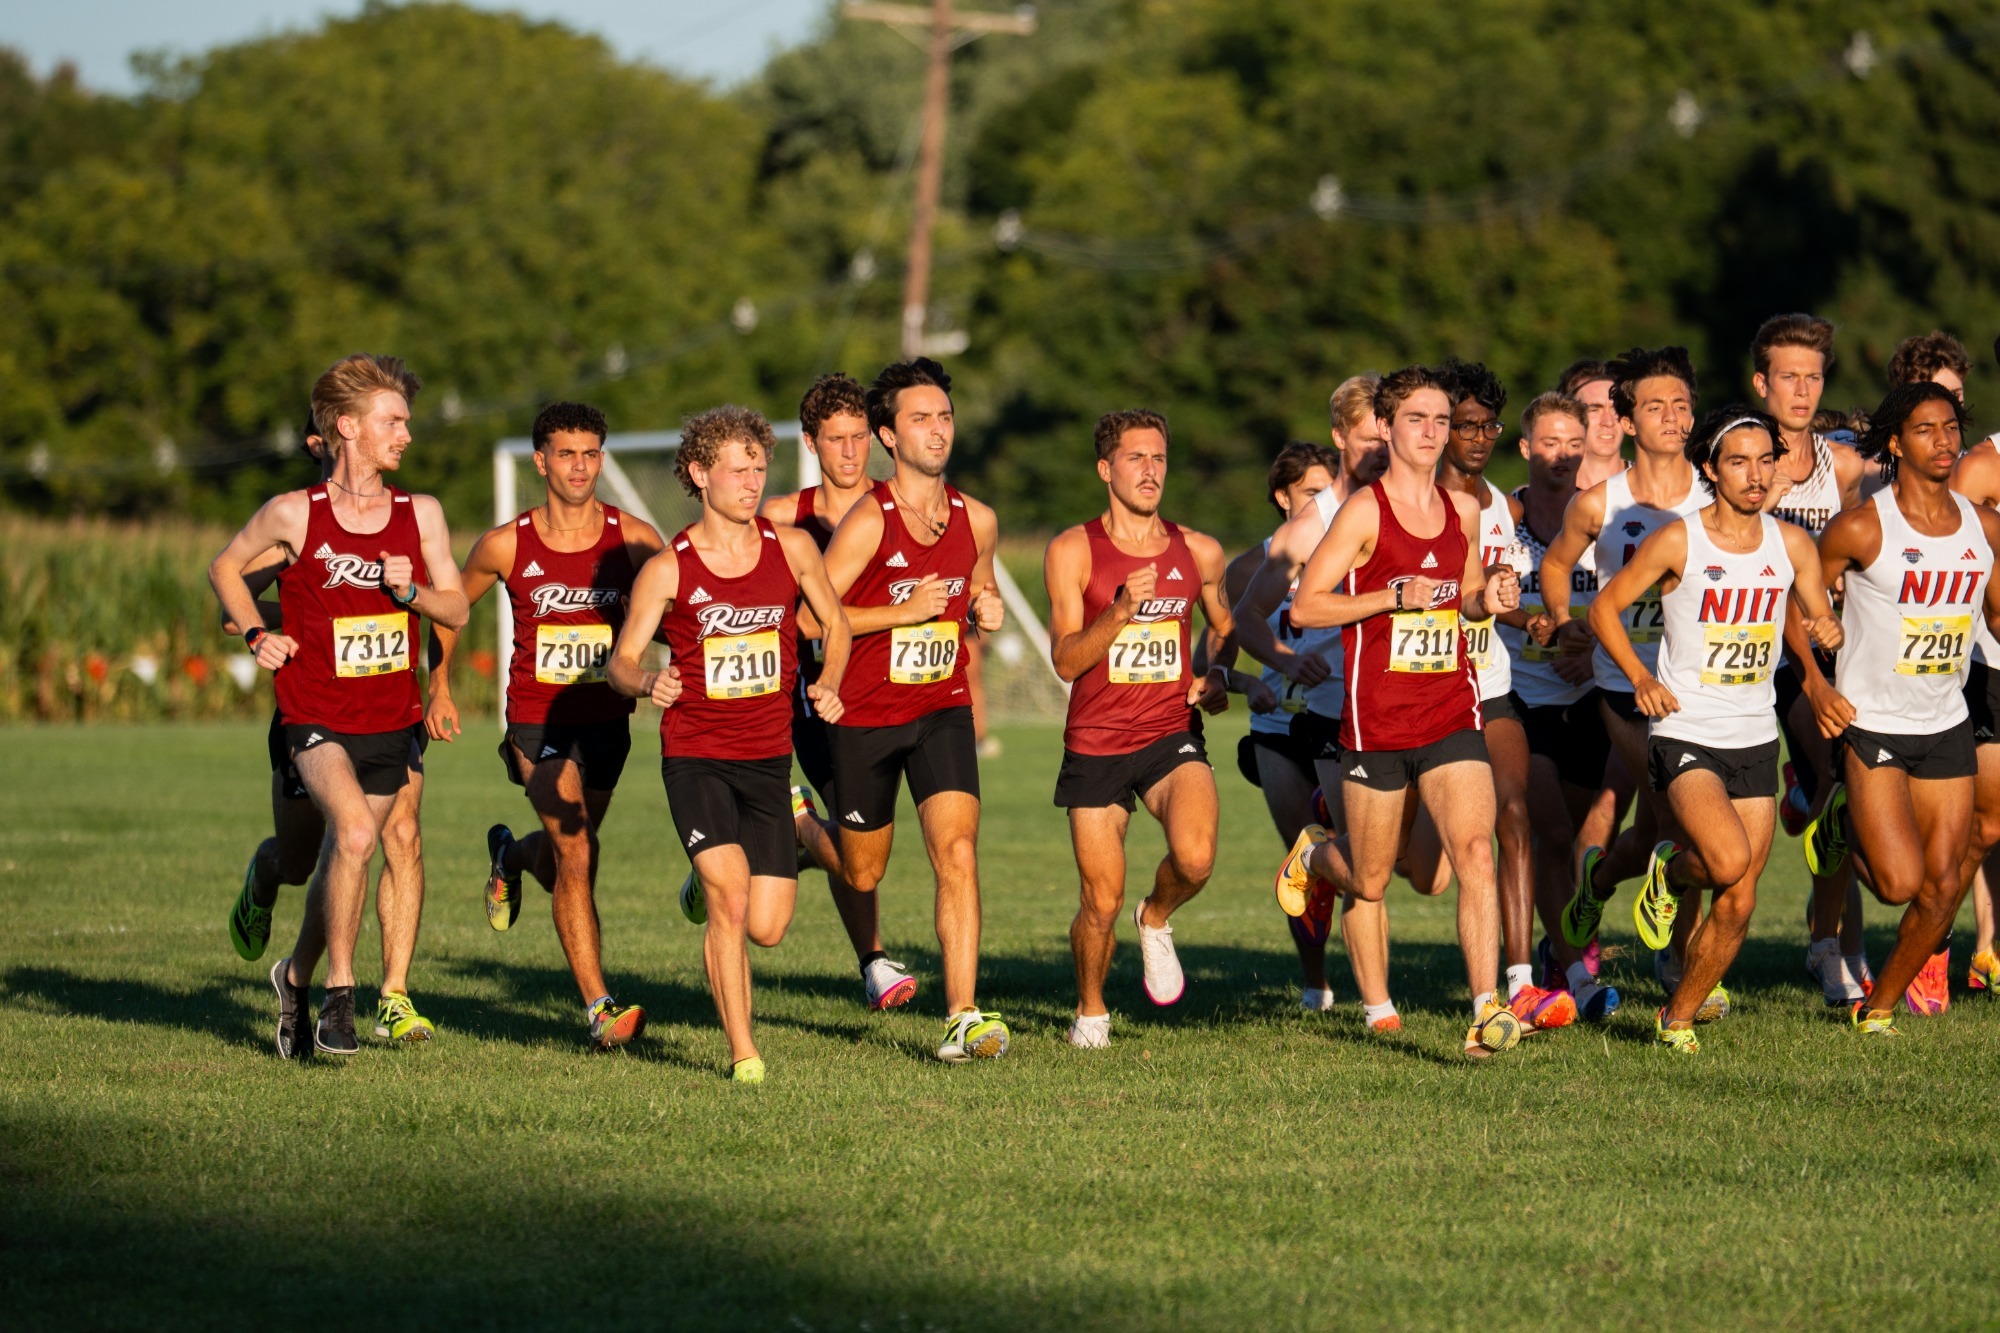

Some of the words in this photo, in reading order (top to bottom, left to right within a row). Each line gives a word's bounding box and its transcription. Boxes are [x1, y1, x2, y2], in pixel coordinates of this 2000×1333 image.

[322, 553, 383, 589] RID
[1481, 545, 1505, 569] IT
[530, 583, 620, 618] RIDER
[1897, 570, 1985, 608] NJIT
[1131, 597, 1188, 624] IDER
[1632, 601, 1664, 628] 72
[1697, 587, 1786, 626] NJIT
[697, 603, 785, 640] RIDER
[340, 630, 405, 662] 7312
[896, 640, 955, 667] 7308
[1114, 639, 1177, 668] 7299
[1397, 628, 1453, 656] 7311
[1466, 627, 1489, 654] 90
[1903, 633, 1964, 660] 7291
[541, 642, 607, 669] 7309
[711, 650, 776, 683] 7310
[1707, 641, 1771, 669] 7293
